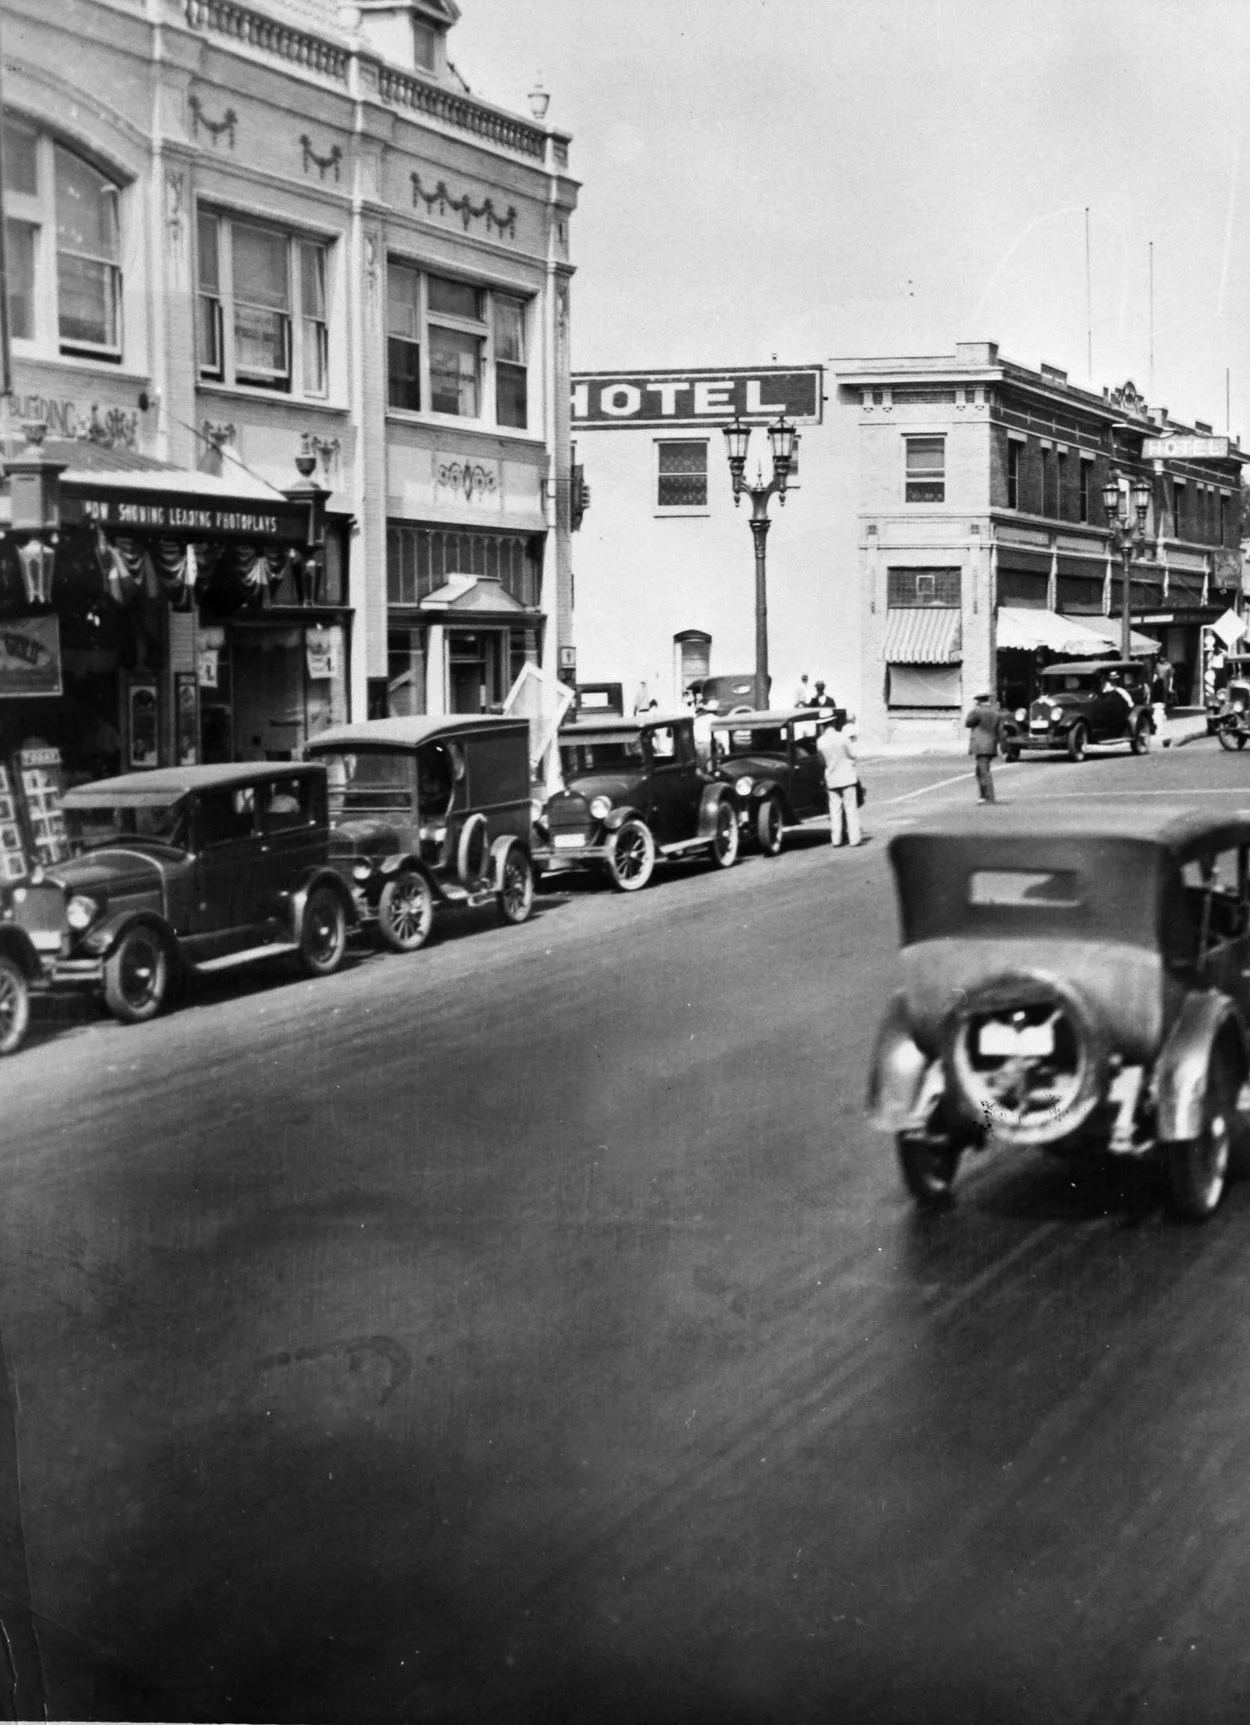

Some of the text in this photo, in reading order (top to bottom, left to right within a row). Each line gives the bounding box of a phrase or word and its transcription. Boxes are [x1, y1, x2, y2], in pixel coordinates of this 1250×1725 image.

[1147, 440, 1221, 456] HOTEL
[85, 500, 276, 532] NOW SHOWING LEADING PHOTOPLAYS
